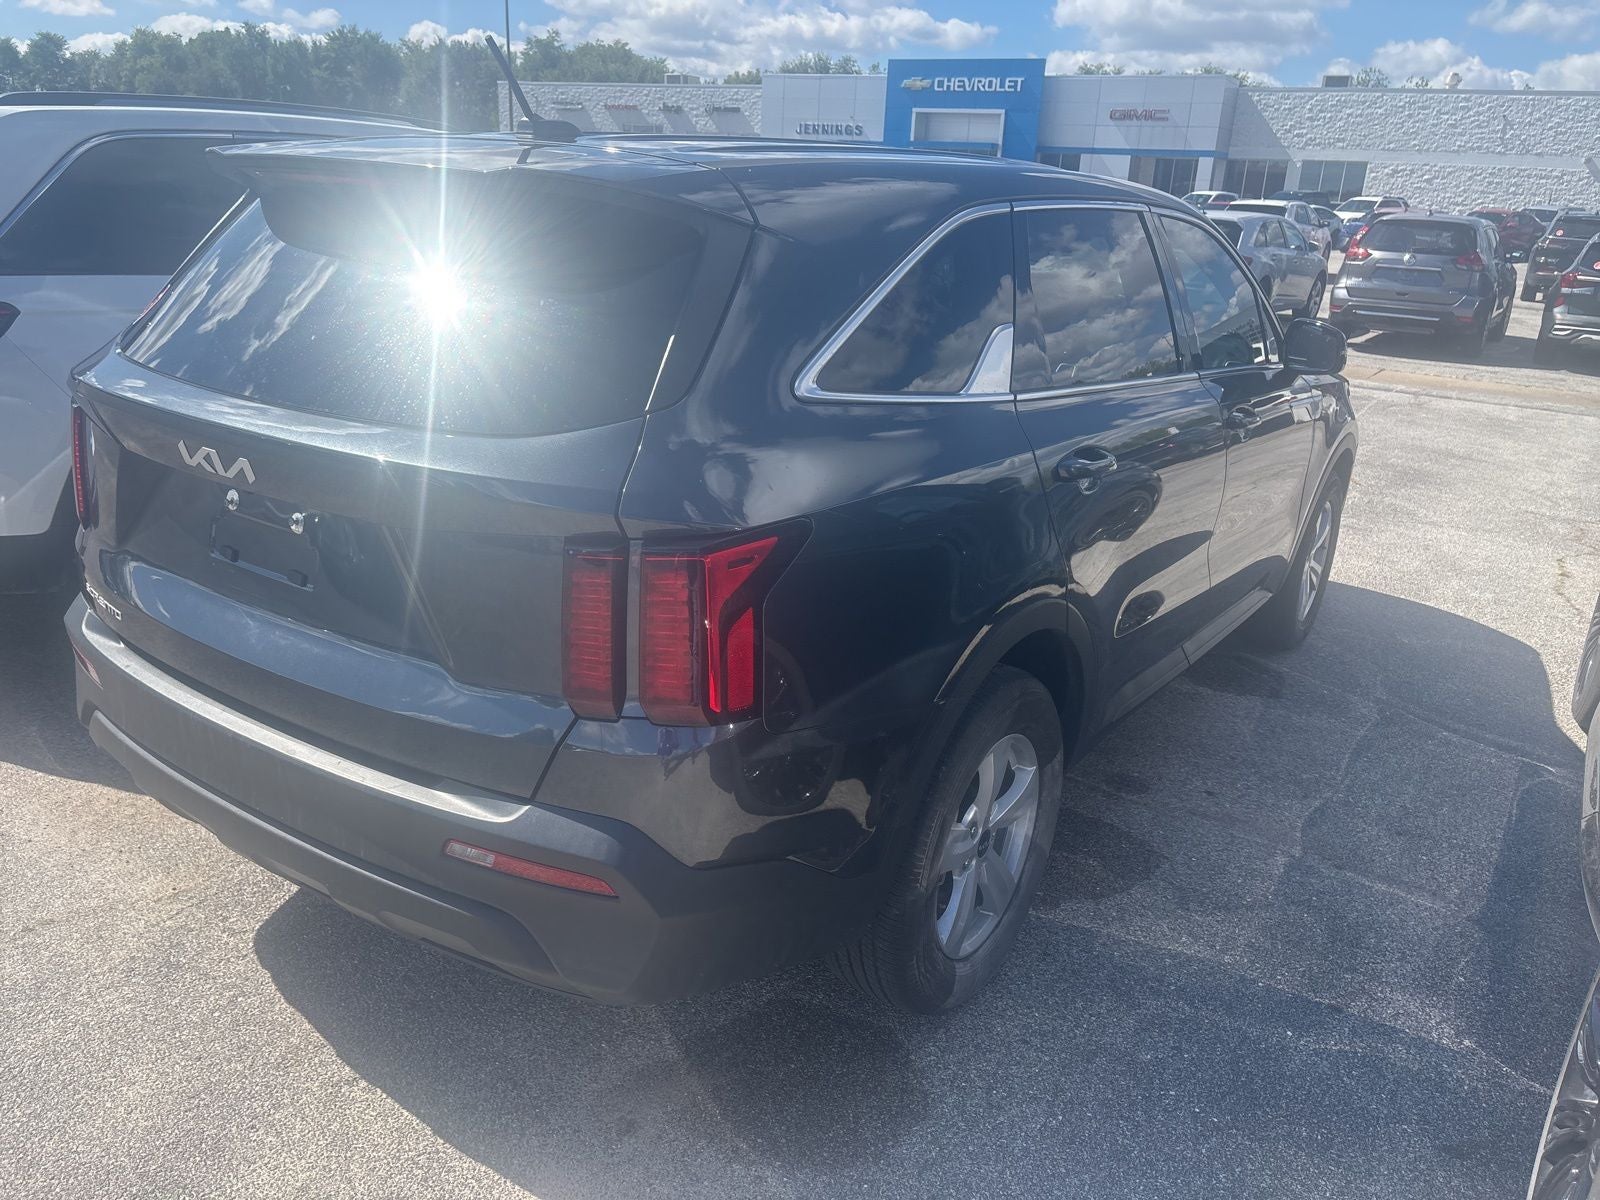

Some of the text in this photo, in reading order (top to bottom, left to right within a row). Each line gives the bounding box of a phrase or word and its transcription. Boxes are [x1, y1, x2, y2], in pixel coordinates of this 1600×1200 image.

[933, 77, 1025, 93] CHEVROLET
[1109, 107, 1170, 122] GMC
[795, 121, 864, 137] JENNINGS
